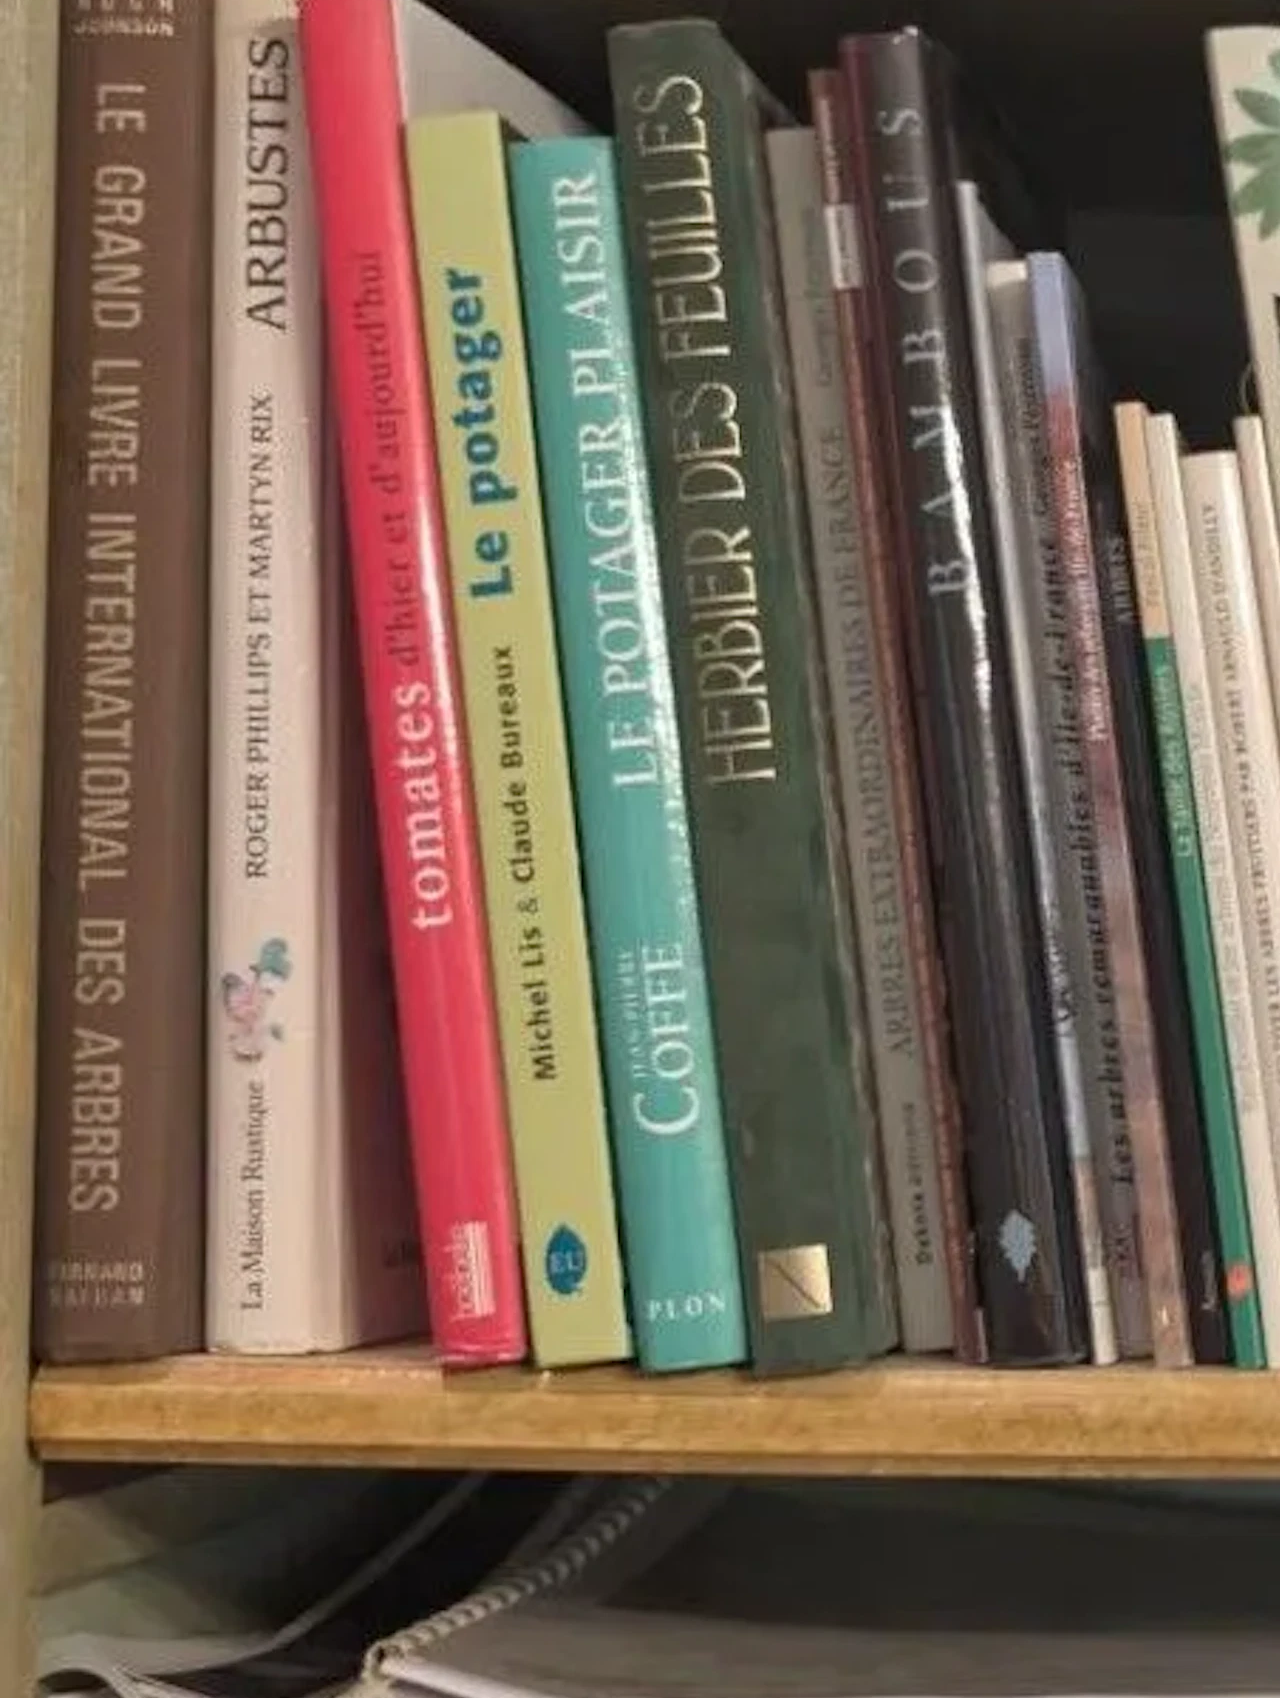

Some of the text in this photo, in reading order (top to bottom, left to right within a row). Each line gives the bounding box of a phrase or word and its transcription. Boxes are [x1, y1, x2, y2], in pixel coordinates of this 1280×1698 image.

[96, 83, 147, 133] LE
[245, 38, 291, 333] ARBUSTES
[88, 164, 146, 329] GRAND
[88, 357, 143, 486] LIVRE
[440, 265, 518, 597] Le potager
[79, 513, 138, 882] INTERNATIONAL
[245, 393, 276, 879] ROGER PHILLIPS ET MARTYN RIX
[351, 249, 453, 930] tomates d'hier et d'aujourd'hui
[76, 916, 127, 1004] DES
[489, 645, 559, 1081] Michel Lis & Claude Bureaux
[67, 1026, 125, 1209] ARBRES
[632, 938, 701, 1136] COFFE
[240, 1079, 269, 1310] La Maison Rustique
